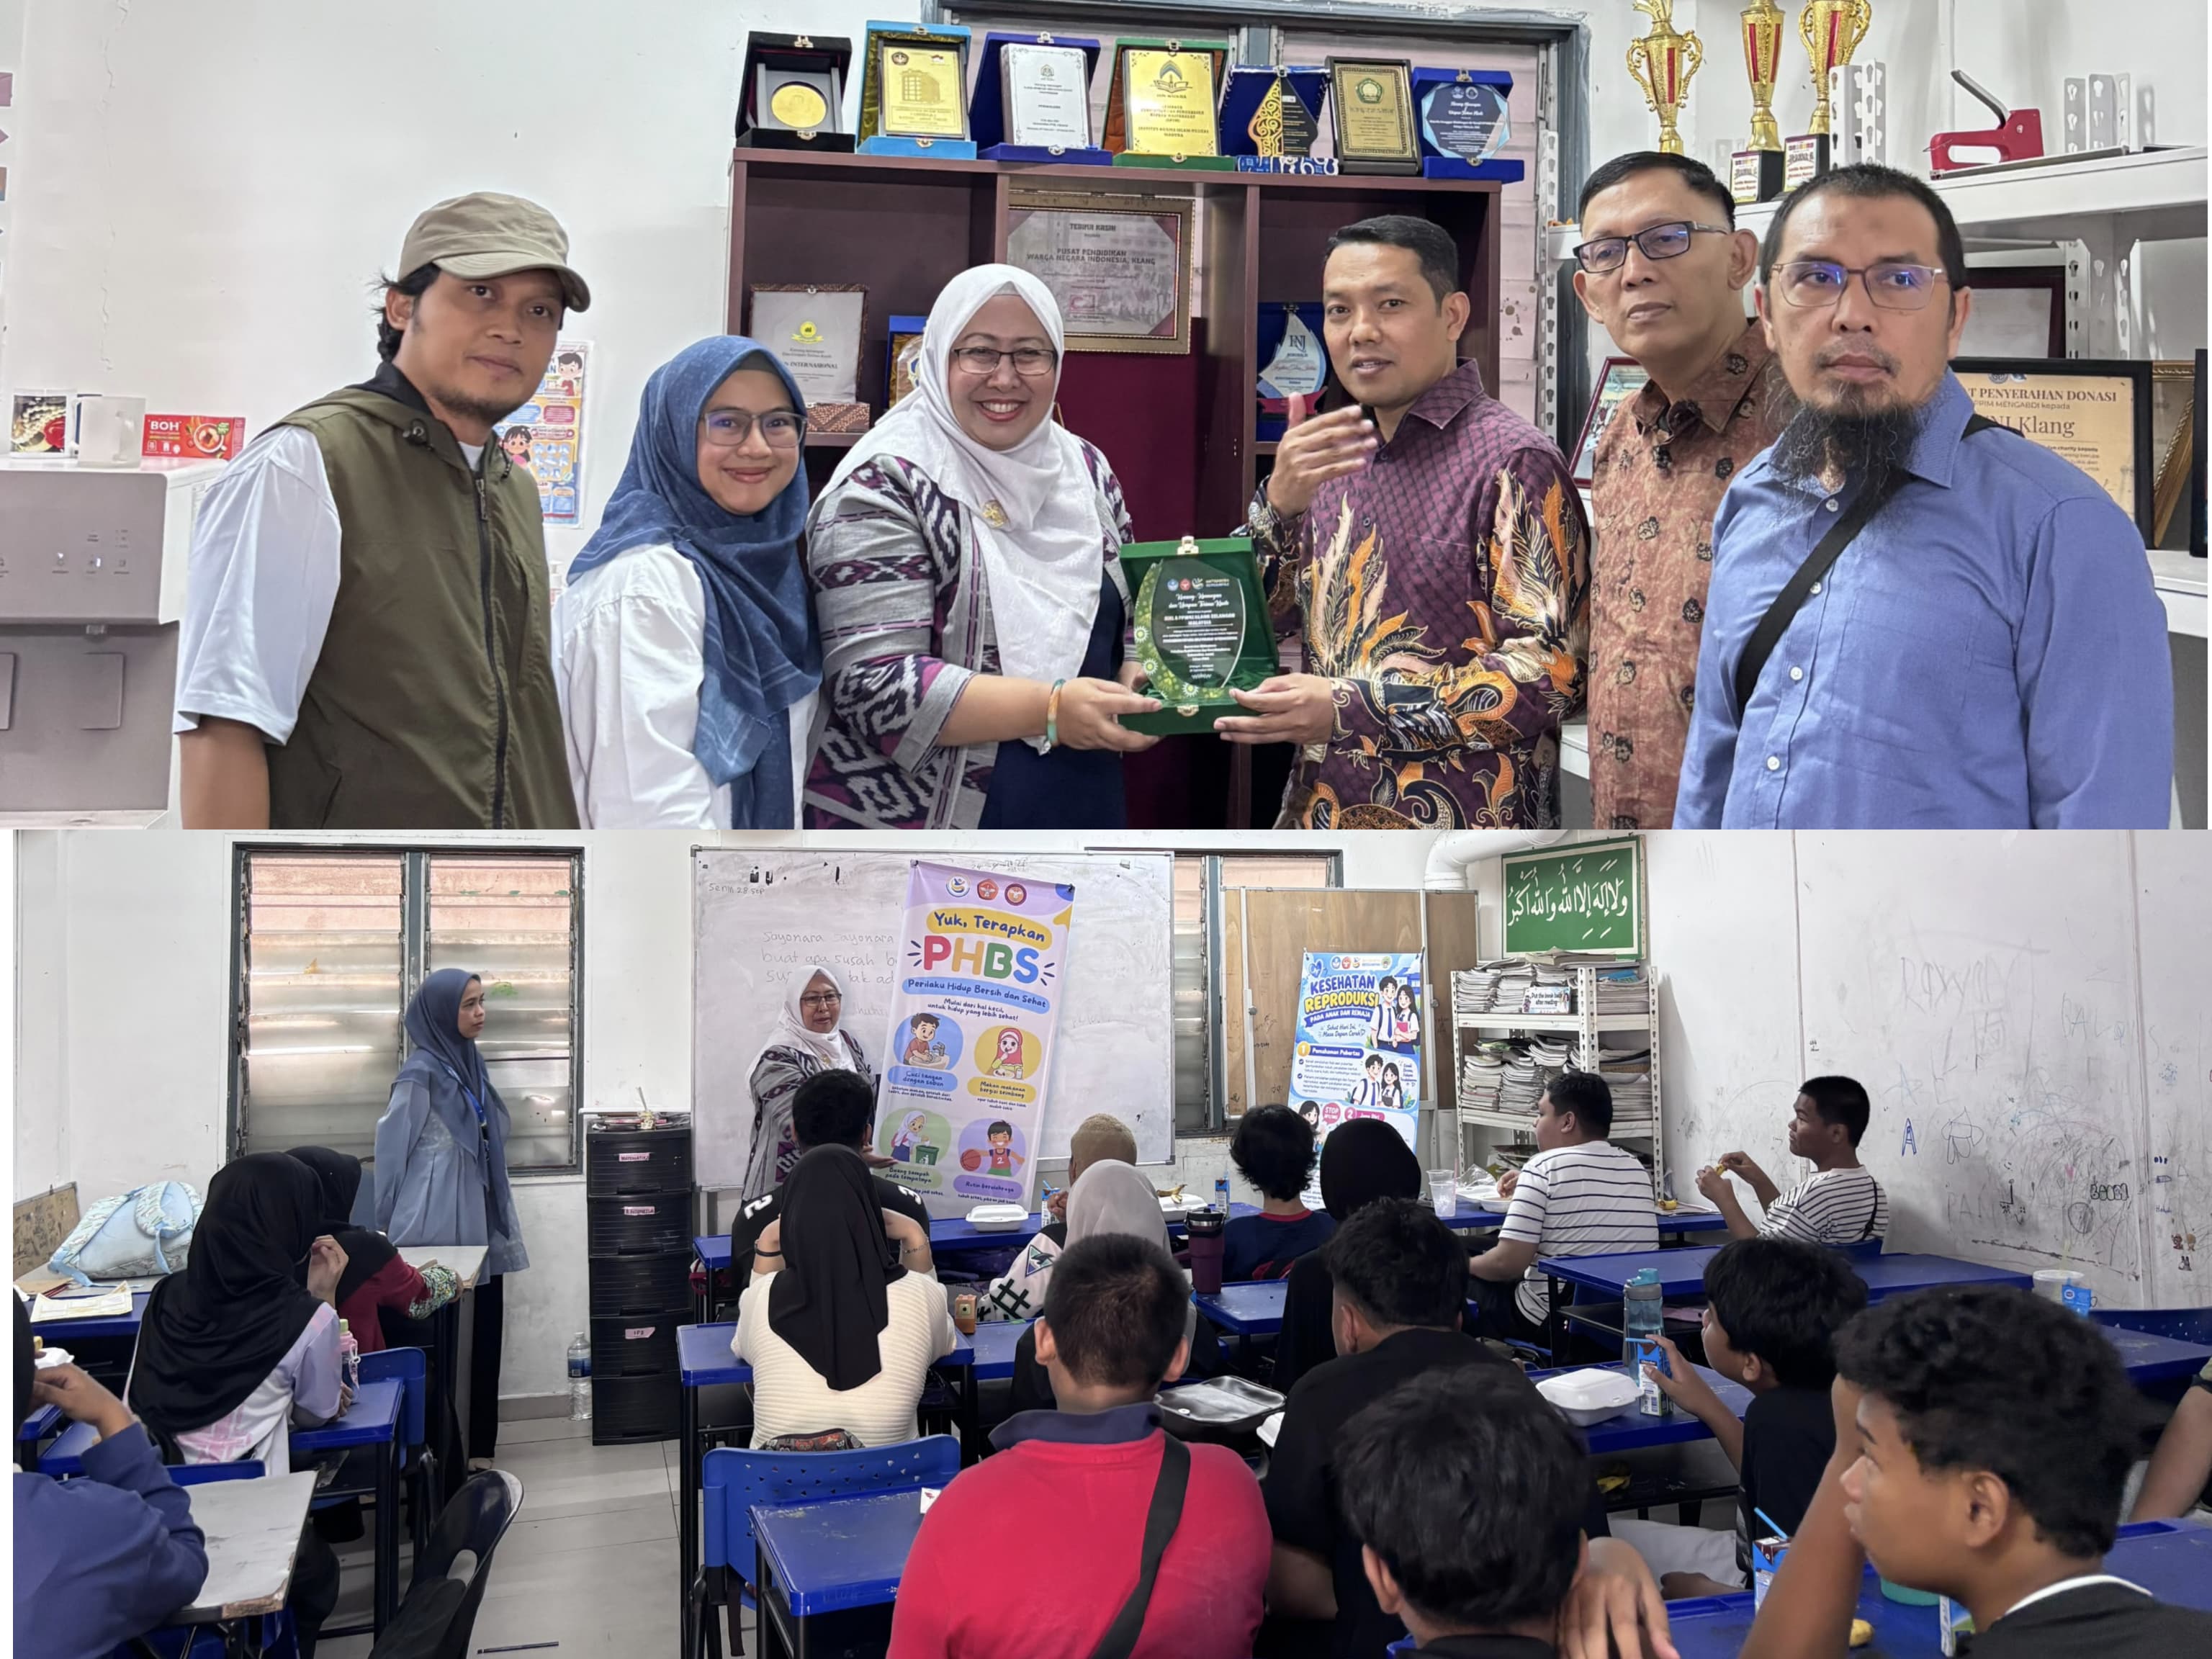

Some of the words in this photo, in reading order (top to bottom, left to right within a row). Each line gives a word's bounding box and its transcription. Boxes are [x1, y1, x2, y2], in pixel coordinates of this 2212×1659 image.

[1056, 254, 1085, 263] NEGARA
[1980, 388, 2063, 400] PENYERAHAN
[2067, 390, 2116, 402] DONASI
[150, 421, 179, 431] BOH
[2019, 415, 2075, 439] Klang
[934, 911, 968, 928] Yuk,
[974, 915, 1046, 943] Terapkan
[760, 947, 799, 963] buat
[835, 953, 875, 966] susah
[924, 935, 1039, 984] PHBS
[908, 979, 945, 989] Perilaku
[947, 981, 972, 994] Hidup
[974, 984, 1002, 997] Bersih
[1004, 992, 1020, 1001] dan
[1022, 994, 1046, 1008] Sehat
[1310, 974, 1376, 995] KESEHATAN
[944, 998, 961, 1007] Mulai
[1304, 991, 1380, 1014] REPRODUKSI
[948, 1005, 964, 1014] hidup
[966, 1009, 981, 1017] yang
[998, 1012, 1019, 1022] sehat!
[999, 1090, 1025, 1100] seimbang
[1347, 1109, 1354, 1118] 2
